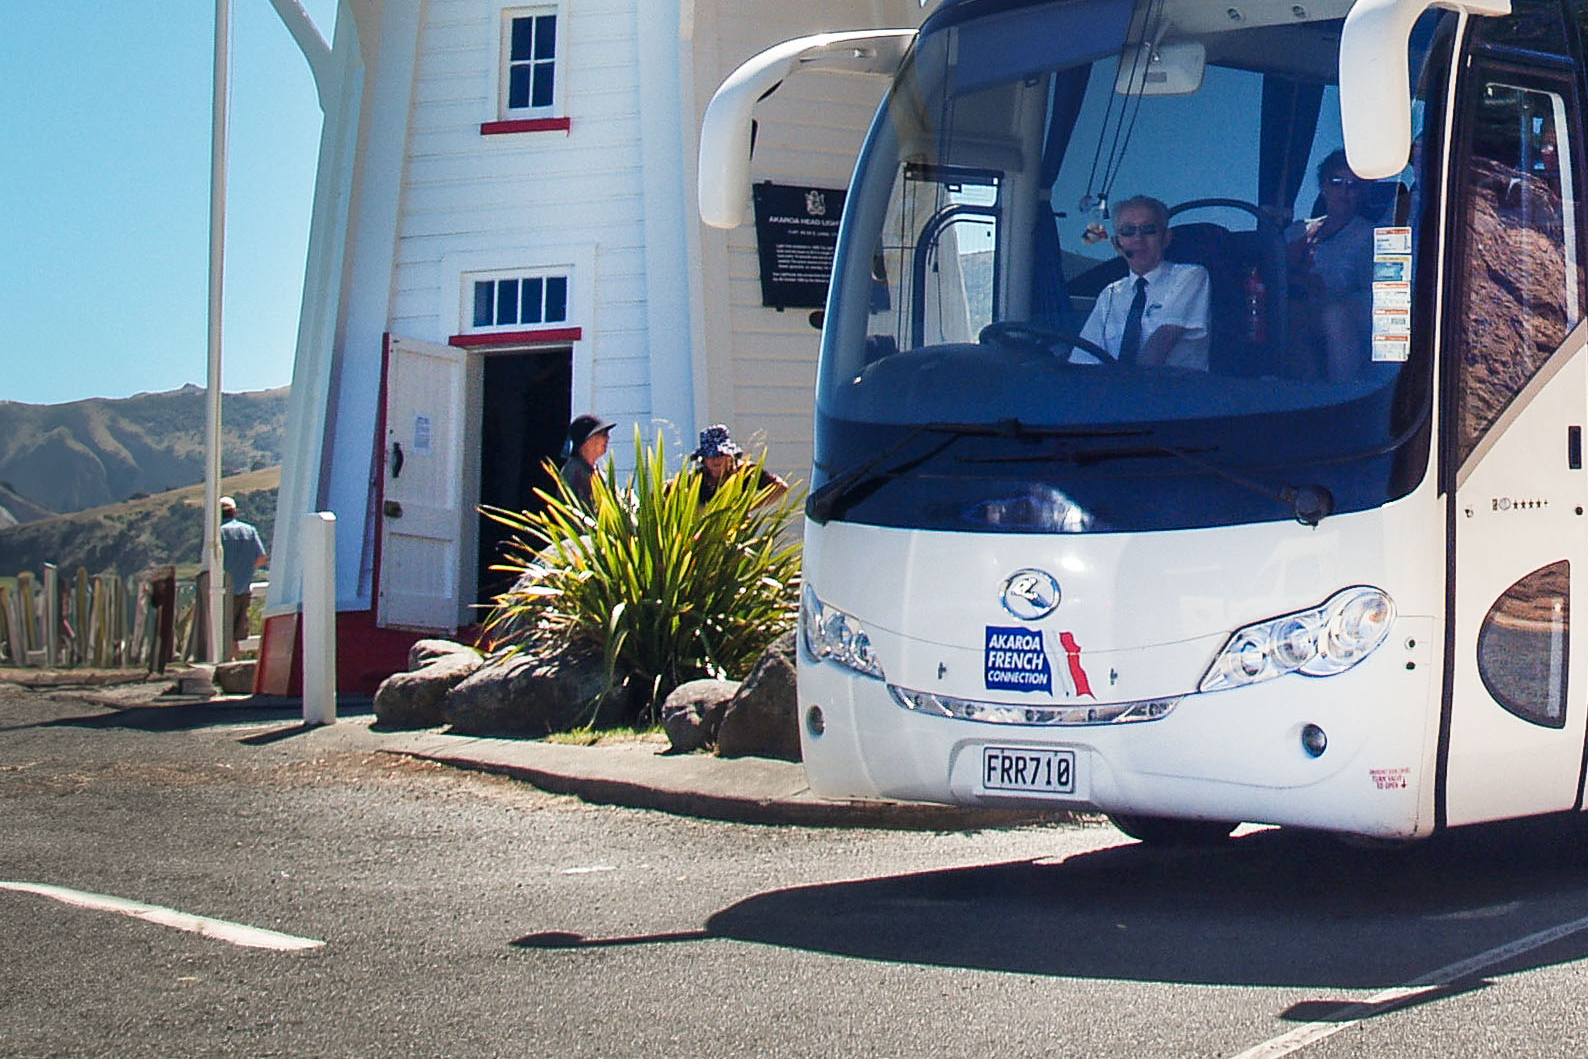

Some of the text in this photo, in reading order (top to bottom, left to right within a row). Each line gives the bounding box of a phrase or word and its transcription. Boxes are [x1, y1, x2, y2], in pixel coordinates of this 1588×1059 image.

[989, 634, 1041, 650] AKAROA
[988, 651, 1044, 670] FRENCH
[988, 670, 1048, 684] CONNECTION
[987, 754, 1070, 786] FRR710
